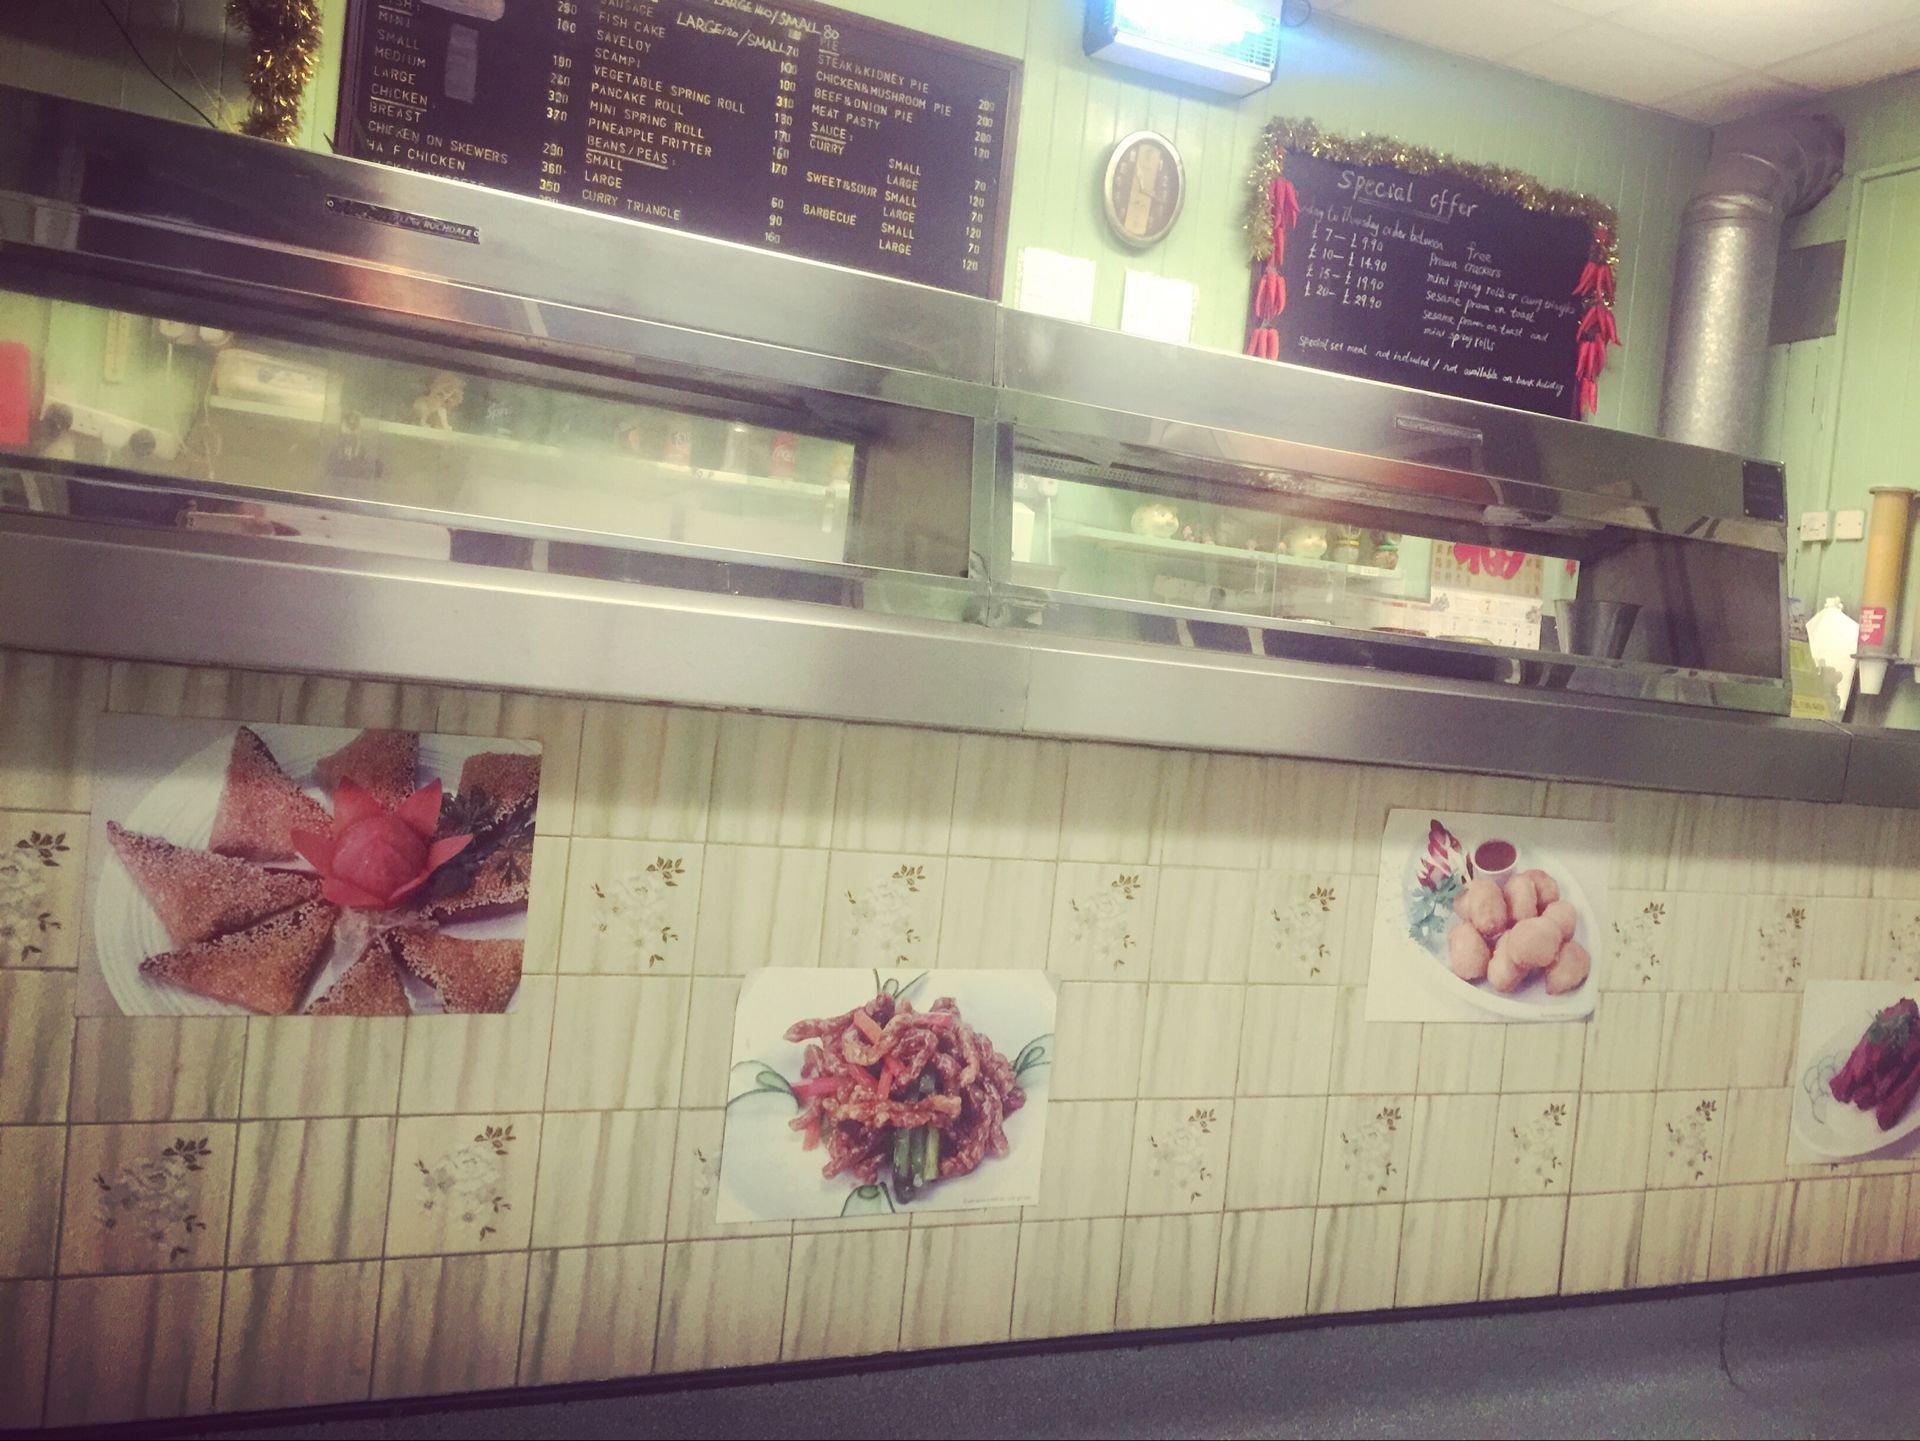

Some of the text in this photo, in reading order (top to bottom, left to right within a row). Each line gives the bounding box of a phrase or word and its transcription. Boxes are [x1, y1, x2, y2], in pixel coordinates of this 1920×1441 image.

[378, 11, 410, 28] MINI
[599, 11, 666, 38] FISH CAKE
[378, 29, 419, 50] SMALL
[823, 24, 839, 40] 80
[597, 30, 652, 53] SAVELOY
[820, 39, 839, 51] PIE
[374, 46, 426, 68] MEDIUM
[595, 48, 641, 68] SCAMPI
[373, 66, 416, 85] LARGE
[371, 83, 428, 106] CHICKEN
[594, 65, 745, 114] VEGETABLE SPRING ROLL
[779, 79, 796, 92] 100
[910, 79, 930, 94] PIE
[591, 82, 684, 116] PANCAKE ROLL
[776, 96, 795, 109] 310
[370, 102, 421, 122] BREAST
[546, 106, 568, 122] 370
[812, 104, 881, 130] MEAT PASTY
[894, 107, 914, 124] PIE
[933, 102, 952, 117] PIE
[590, 100, 704, 139] MINI SPRING ROLL
[368, 120, 508, 165] CHICKEN ON SKEWERS
[588, 118, 712, 158] PINEAPPLE FRITTER
[809, 138, 844, 156] CURRY
[408, 148, 466, 171] CHICKEN
[586, 153, 623, 172] SMALL
[888, 158, 922, 176] SMALL
[584, 170, 622, 189] LARGE
[886, 174, 919, 192] LARGE
[974, 180, 987, 192] 70
[770, 197, 784, 210] 60
[884, 191, 917, 208] SMALL
[969, 195, 985, 208] 120
[1337, 170, 1478, 219] Special offer
[582, 188, 618, 206] CURRY
[626, 199, 680, 221] TRIANGLE
[803, 204, 914, 240] BARBECUE SMALL
[883, 207, 916, 224] LARGE
[971, 211, 984, 224] 70
[966, 227, 982, 240] 120
[1383, 220, 1406, 240] order
[879, 238, 912, 256] LARGE
[968, 242, 980, 255] 70
[962, 258, 978, 272] 120
[1360, 256, 1388, 272] 14.90
[1426, 272, 1449, 286] mini
[1454, 279, 1482, 298] spring
[1508, 292, 1518, 300] or
[1426, 290, 1462, 308] sesame
